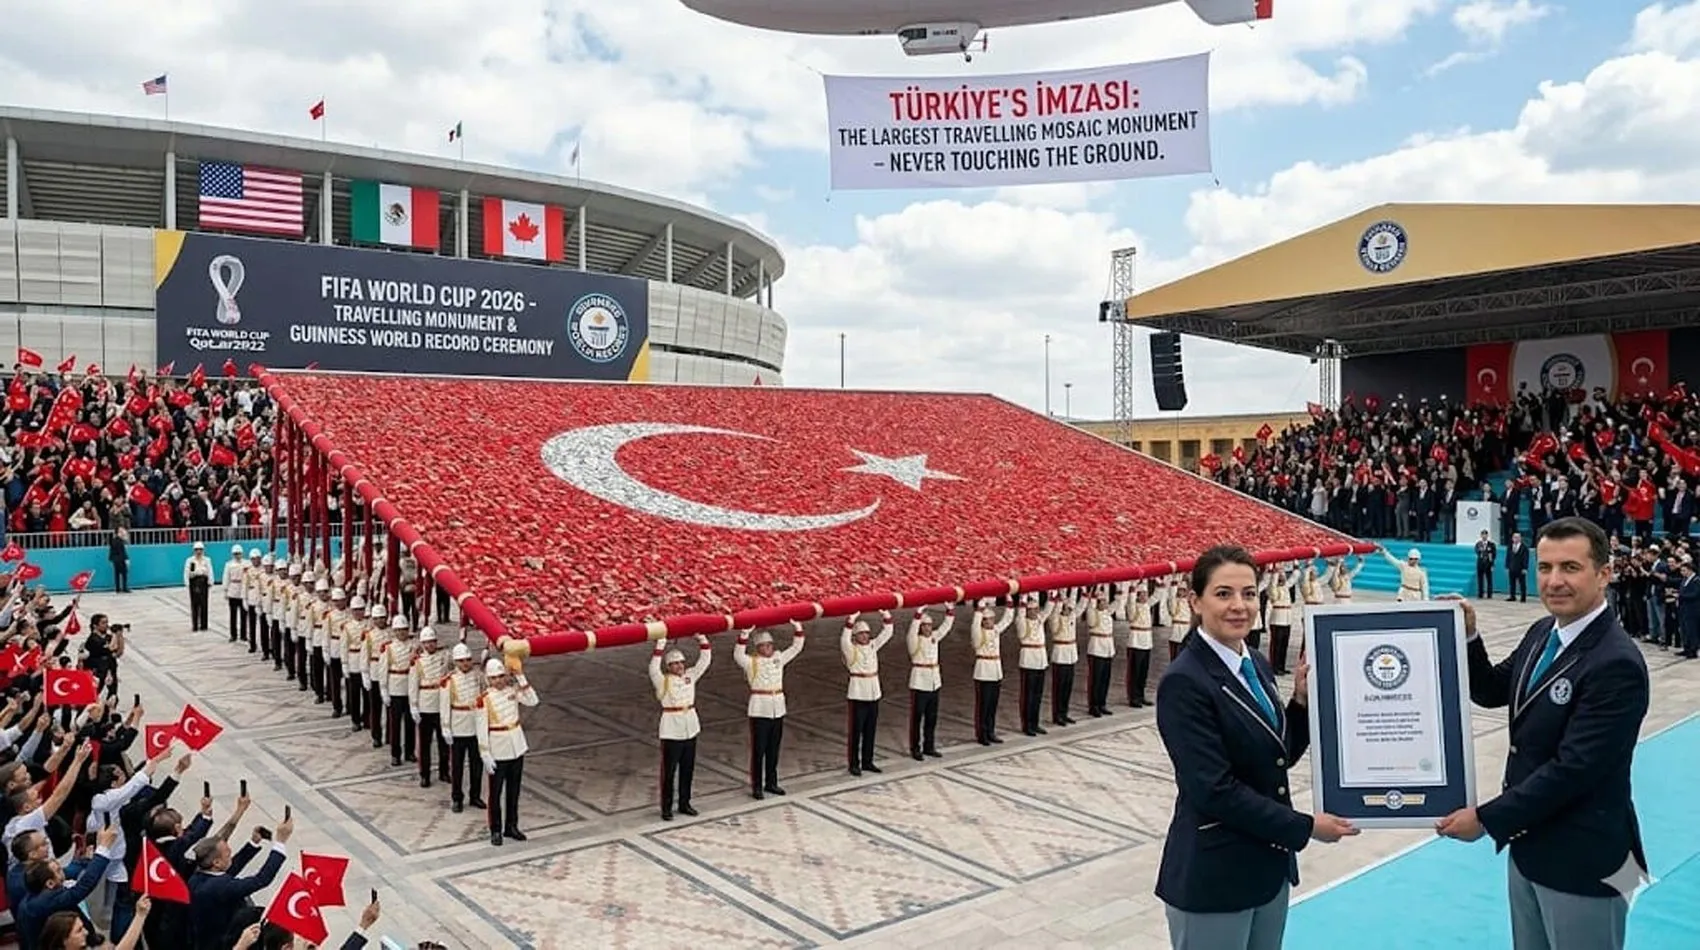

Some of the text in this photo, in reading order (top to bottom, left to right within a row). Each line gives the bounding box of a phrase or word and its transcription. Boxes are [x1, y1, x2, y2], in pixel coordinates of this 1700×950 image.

[890, 80, 1140, 121] TÜRKİYE'S İMZASI:
[838, 111, 1198, 147] THE LARGEST TRAVELLING MOSAIC MONUMENT
[890, 152, 945, 173] NEVER
[951, 148, 1040, 171] TOUCHING
[1047, 146, 1078, 167] THE
[1084, 140, 1165, 164] GROUND.
[321, 276, 363, 301] FIFA
[368, 280, 435, 305] WORLD
[440, 286, 477, 308] CUP
[481, 289, 526, 312] 2026
[334, 305, 518, 333] TRAVELLING MONUMENT &
[290, 325, 554, 356] GUINNESS WORLD RECORD CEREMONY
